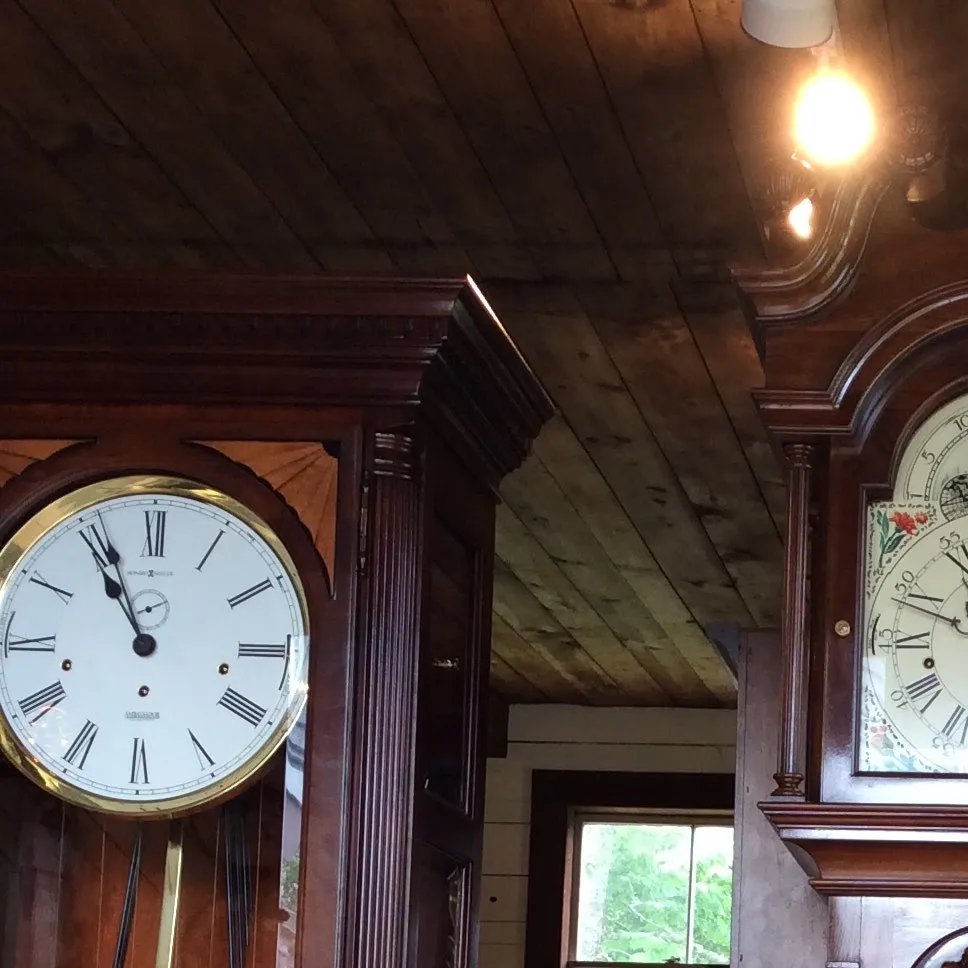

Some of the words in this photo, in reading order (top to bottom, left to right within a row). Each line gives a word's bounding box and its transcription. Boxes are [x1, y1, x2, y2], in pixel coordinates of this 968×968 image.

[921, 451, 935, 465] 5
[77, 522, 110, 573] XI
[140, 510, 167, 558] XII
[195, 528, 226, 572] I
[939, 531, 960, 550] 55
[29, 569, 74, 606] X
[227, 576, 274, 610] II
[894, 570, 915, 595] 50
[238, 641, 286, 659] III
[216, 685, 268, 729] IIII
[62, 719, 99, 770] VII
[128, 737, 150, 784] VI
[187, 727, 216, 771] V
